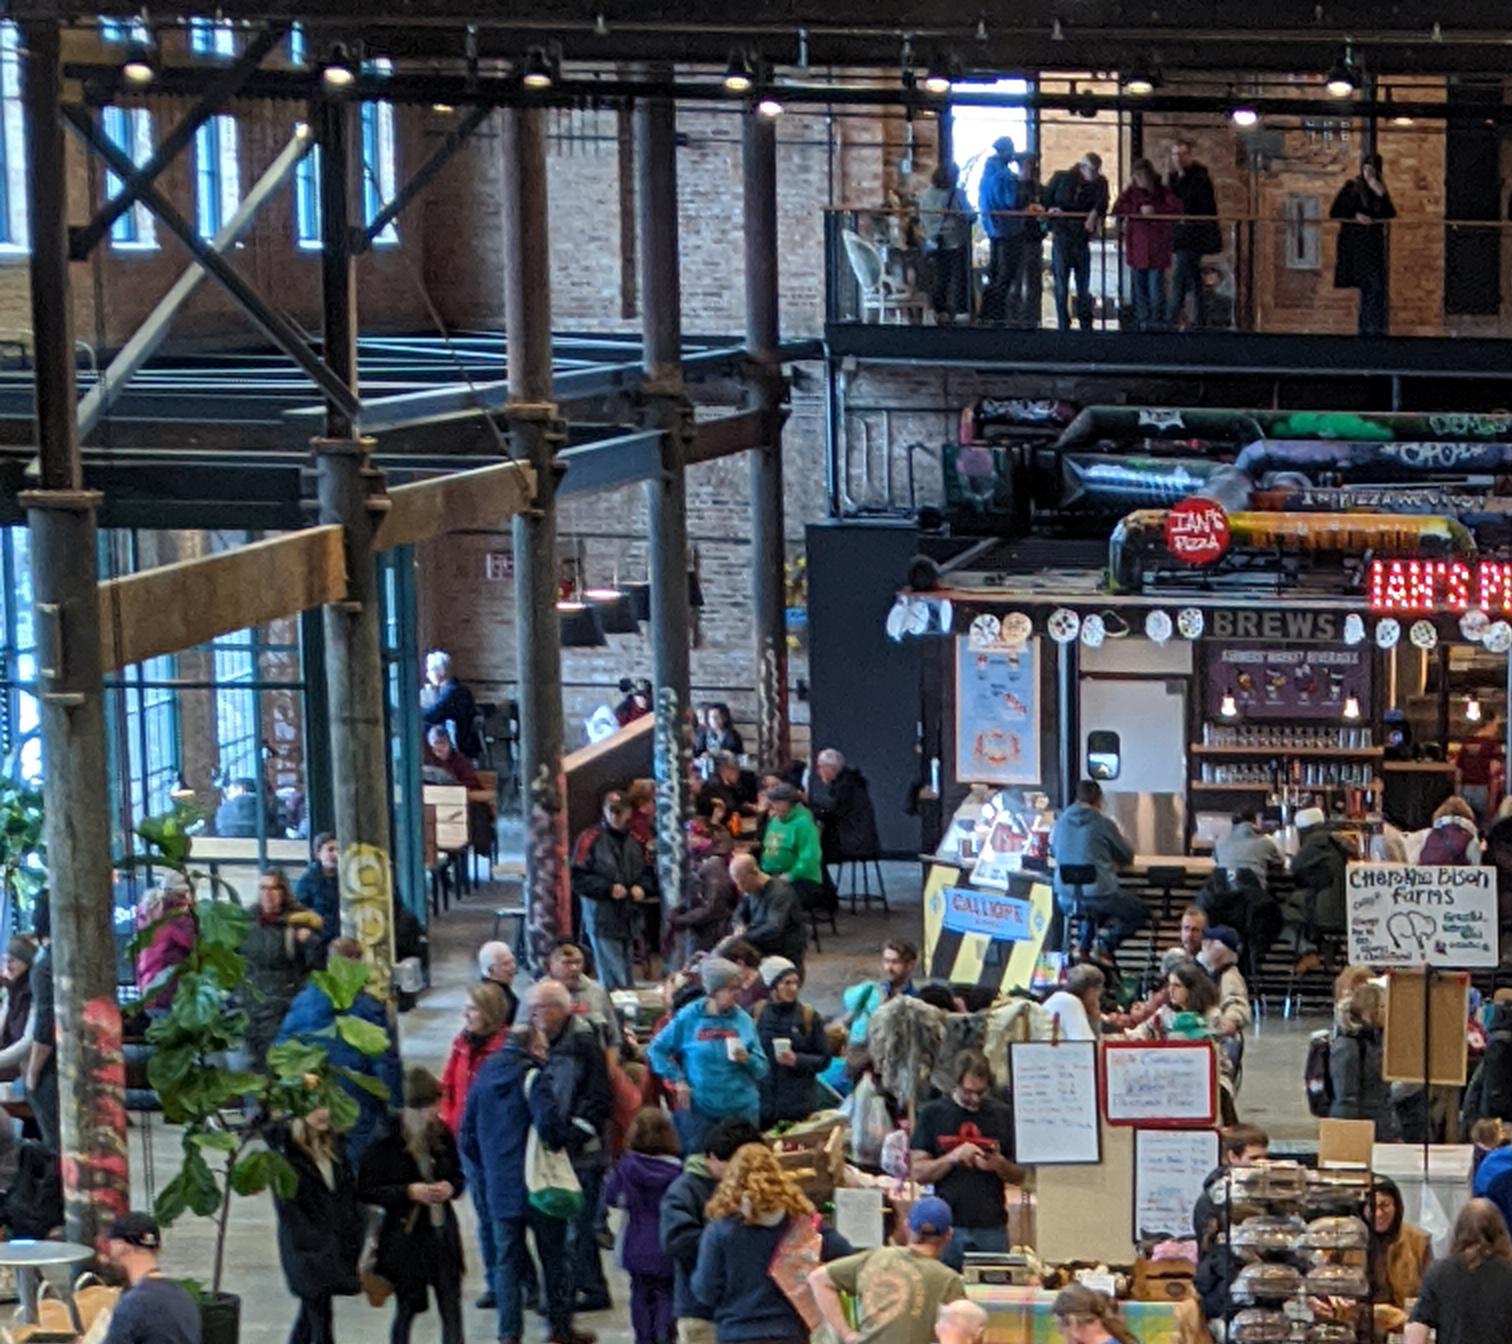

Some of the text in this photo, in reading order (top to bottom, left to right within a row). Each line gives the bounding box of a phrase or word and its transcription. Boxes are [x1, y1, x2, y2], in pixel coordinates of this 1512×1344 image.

[1169, 509, 1225, 534] IAN'S
[1174, 534, 1221, 552] PIZZA
[1370, 560, 1470, 610] IAN'S
[1212, 611, 1336, 640] BREWS
